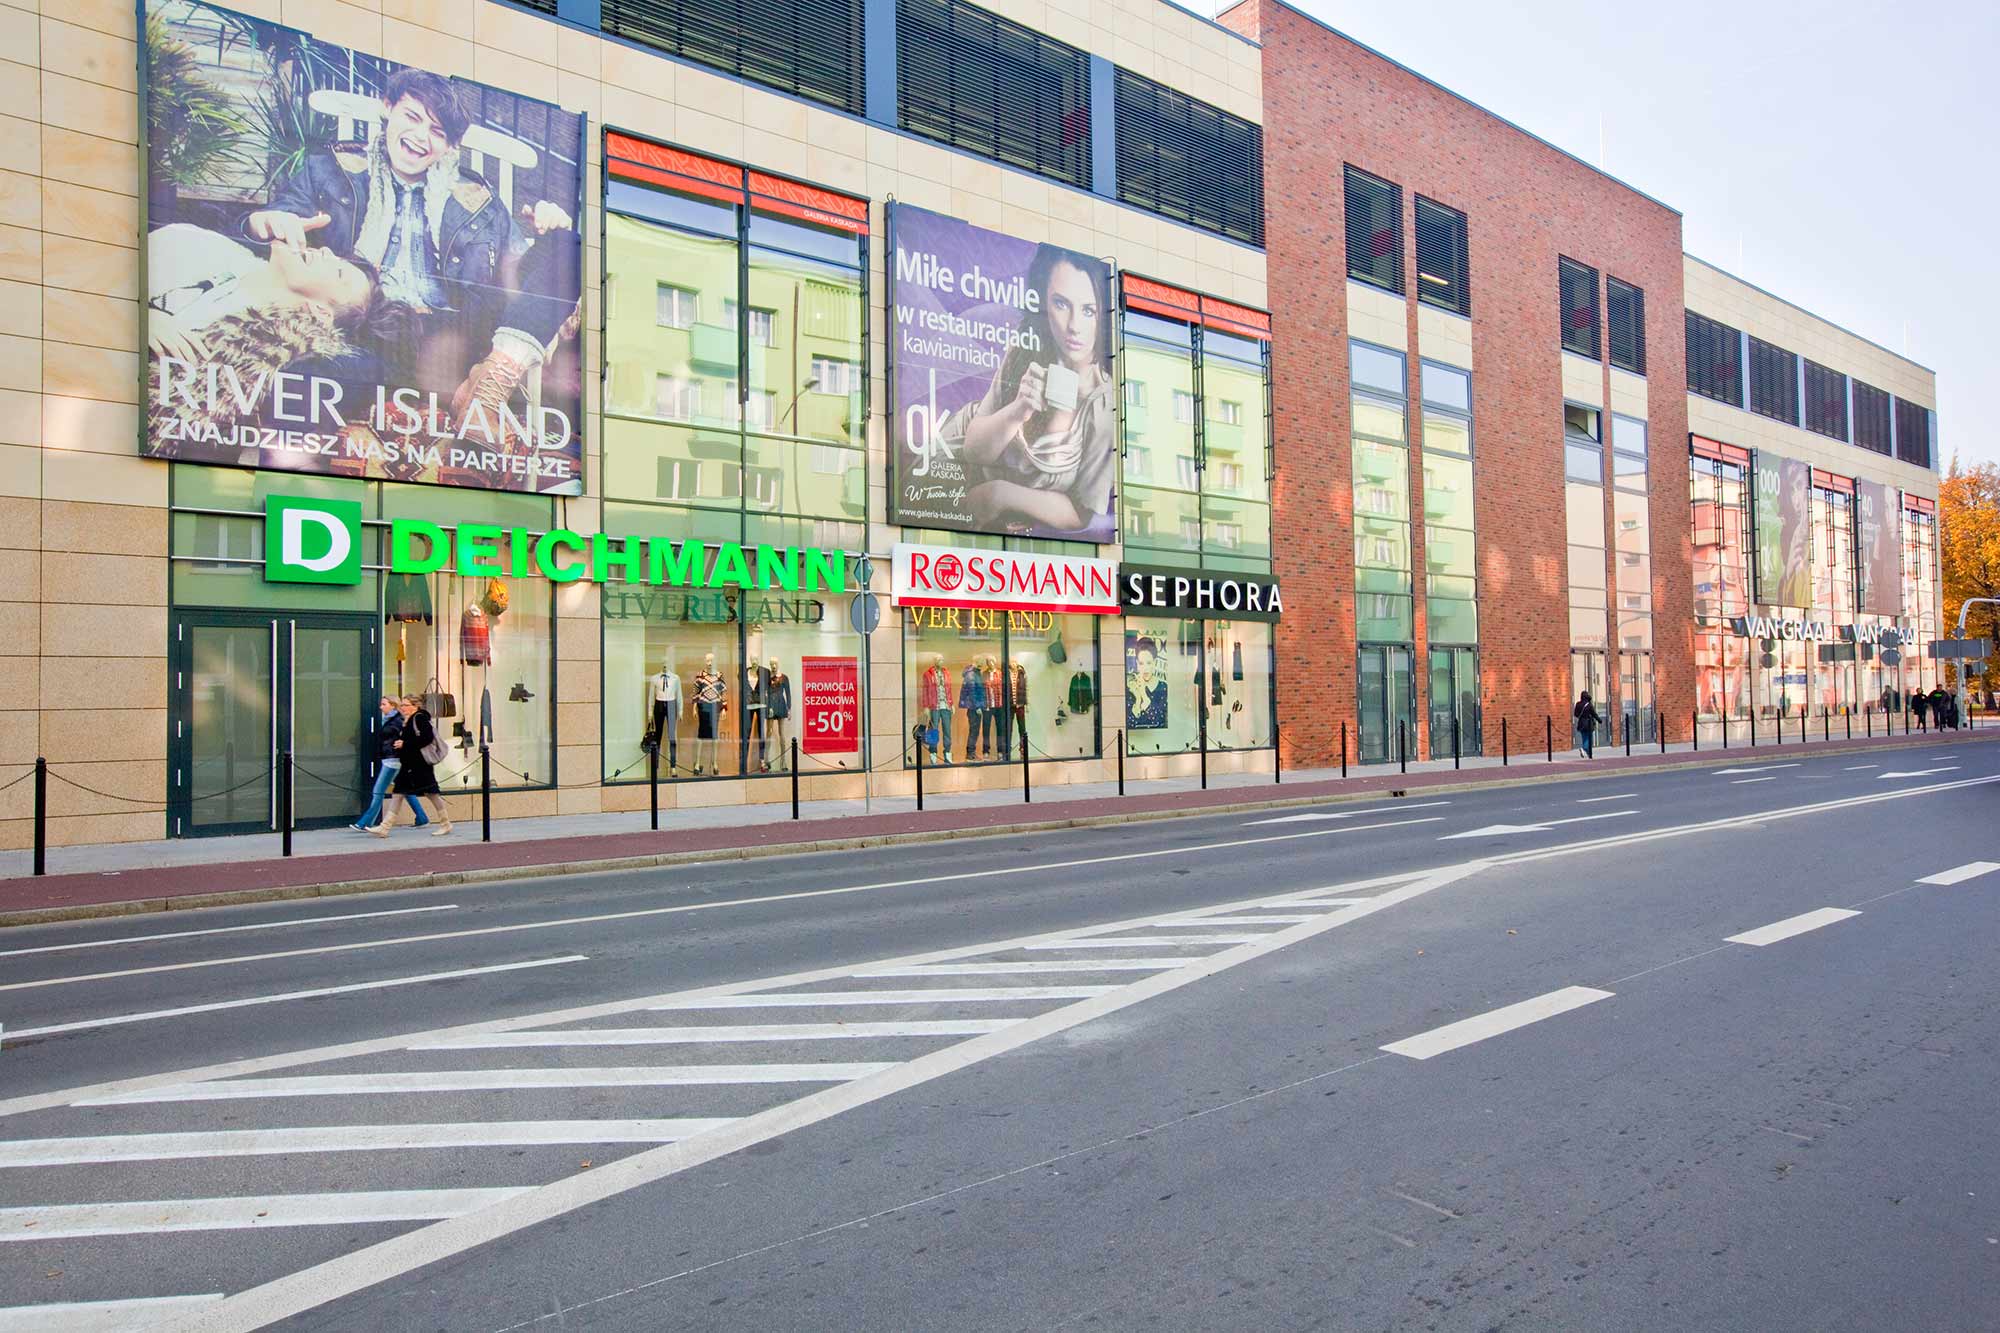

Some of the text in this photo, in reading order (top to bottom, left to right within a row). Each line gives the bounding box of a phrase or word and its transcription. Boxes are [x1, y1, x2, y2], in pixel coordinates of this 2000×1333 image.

[830, 216, 858, 230] KASKADA
[897, 247, 1040, 313] Miłe chwile
[896, 303, 1041, 352] w restauracjach
[903, 329, 1001, 369] kawiarniach
[159, 355, 572, 450] RIVER ISLAND
[906, 367, 954, 476] gk
[158, 416, 571, 479] ZNAJDZIESZ NAS NA PARTERZE
[930, 460, 966, 481] GALERIA KASKADA
[898, 507, 973, 523] www.galeria-kaskada.pl
[282, 508, 351, 572] D
[391, 518, 845, 594] DEICHMANN
[911, 552, 1113, 598] ROSSMANN
[1129, 573, 1284, 613] SEPHORA
[969, 608, 1054, 632] ISLAND
[1745, 615, 1779, 640] VAN
[1852, 623, 1878, 644] VAN
[804, 695, 856, 706] SEZONOWA
[805, 681, 855, 692] PROMOCJA
